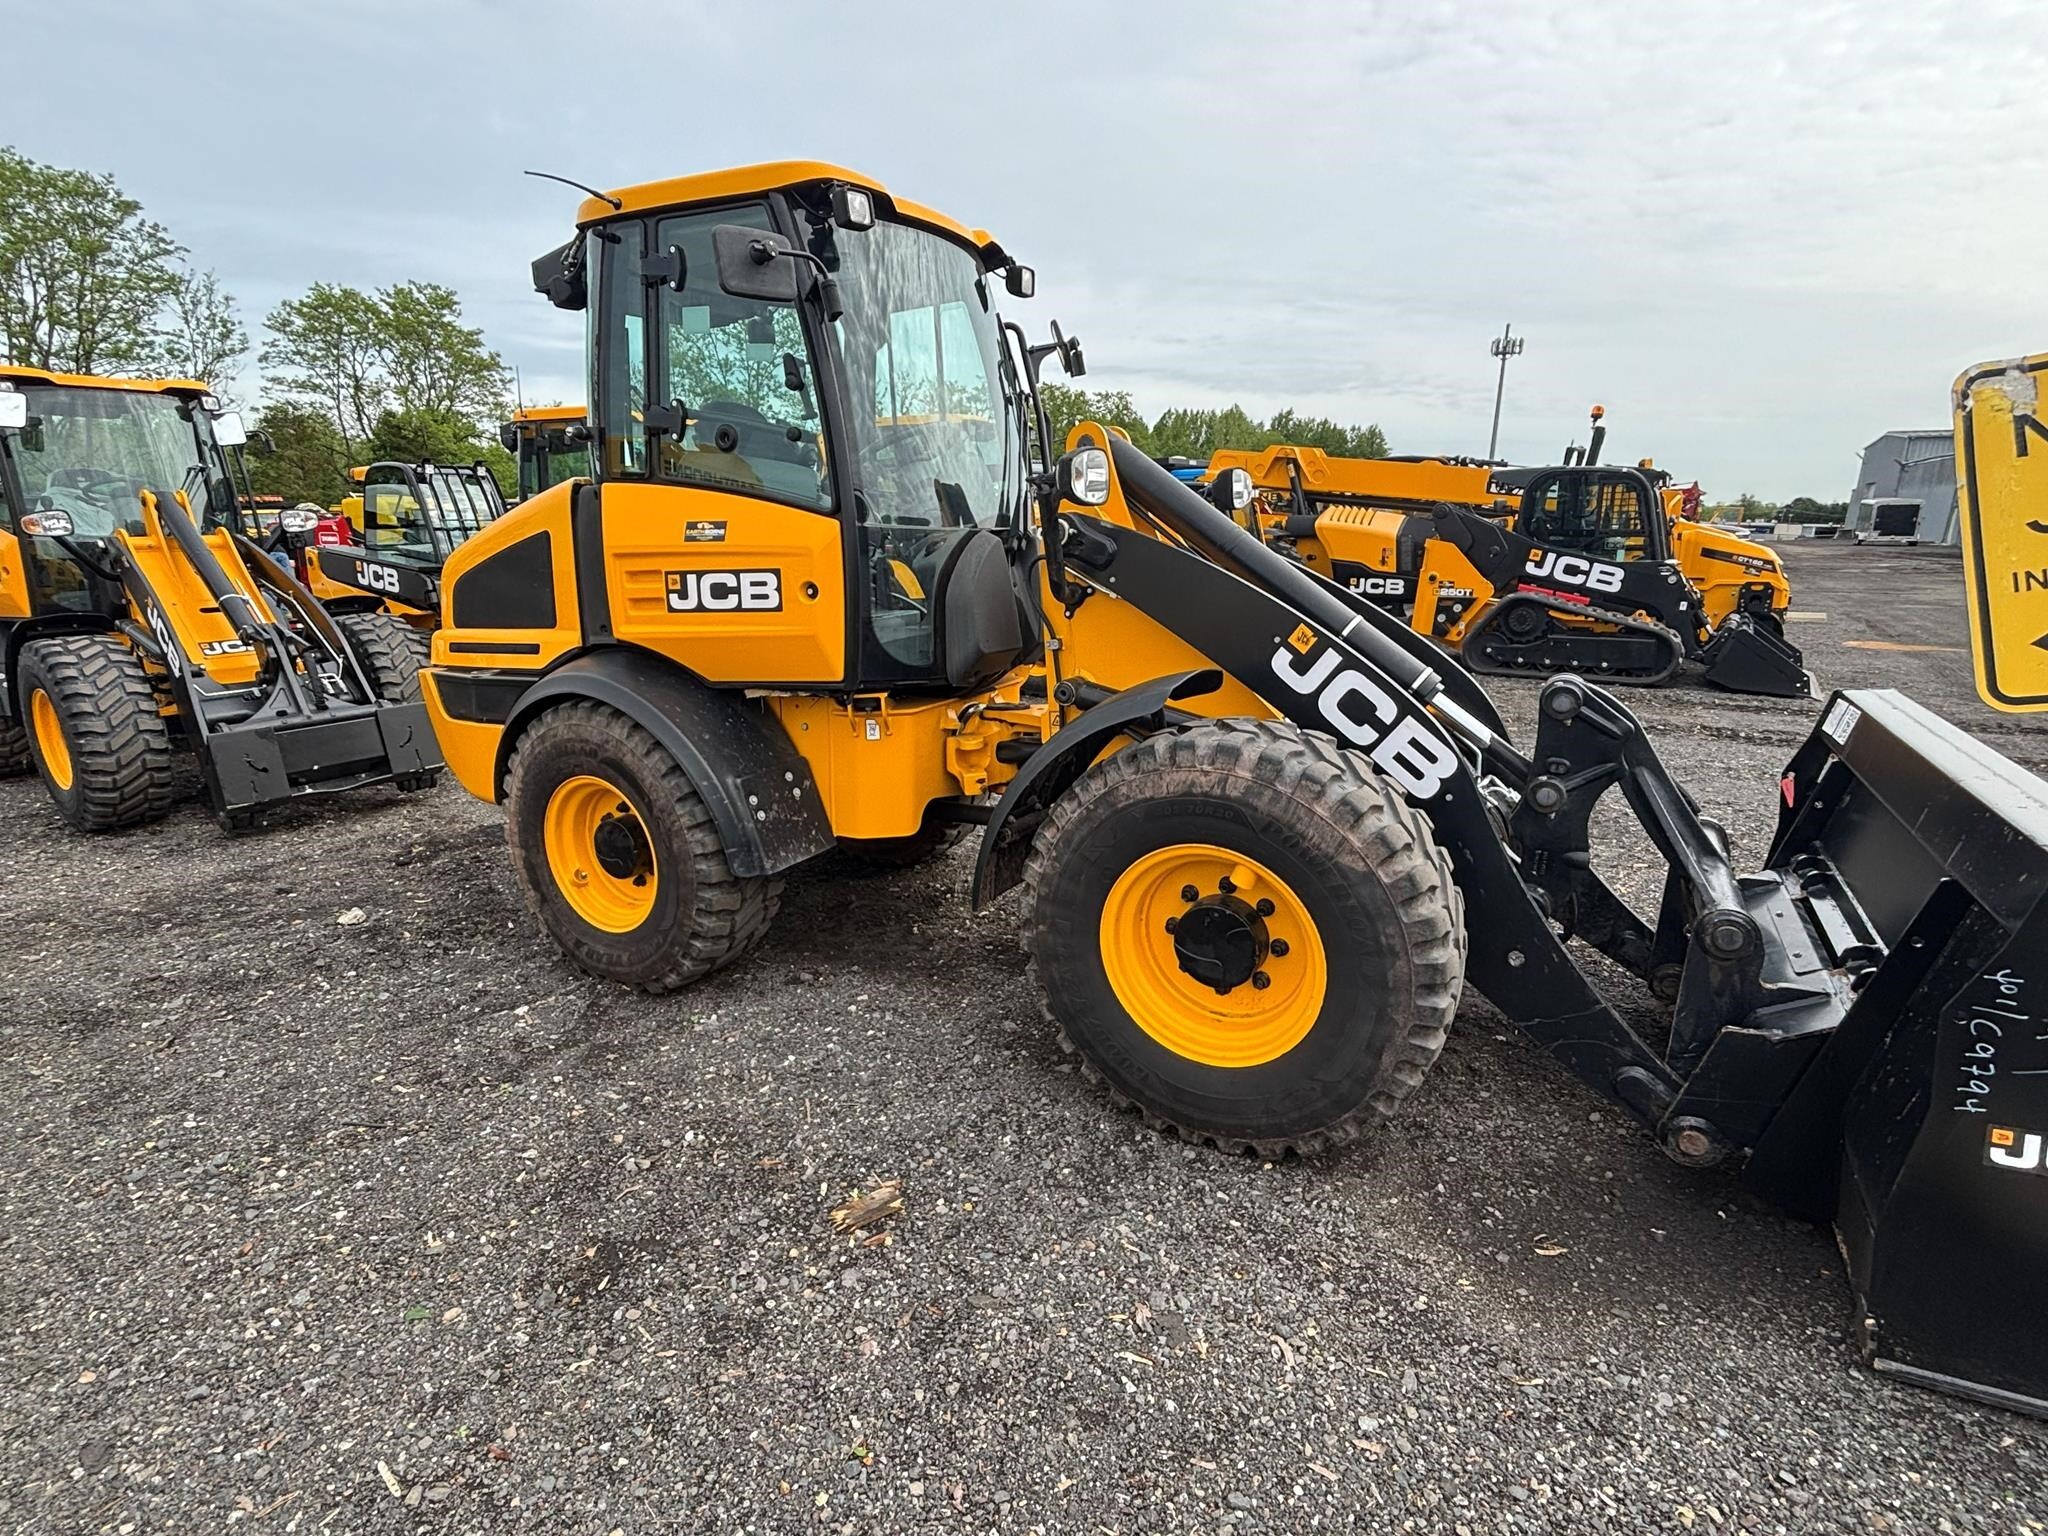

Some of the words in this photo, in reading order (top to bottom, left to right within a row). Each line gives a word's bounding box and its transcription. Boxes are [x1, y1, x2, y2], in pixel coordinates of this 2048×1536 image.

[357, 561, 400, 594] JCB
[669, 572, 780, 610] JCB
[1350, 578, 1405, 595] JCB
[1525, 552, 1625, 593] JCB
[147, 607, 180, 678] JCB
[203, 640, 255, 656] JC
[1271, 646, 1459, 799] JCB
